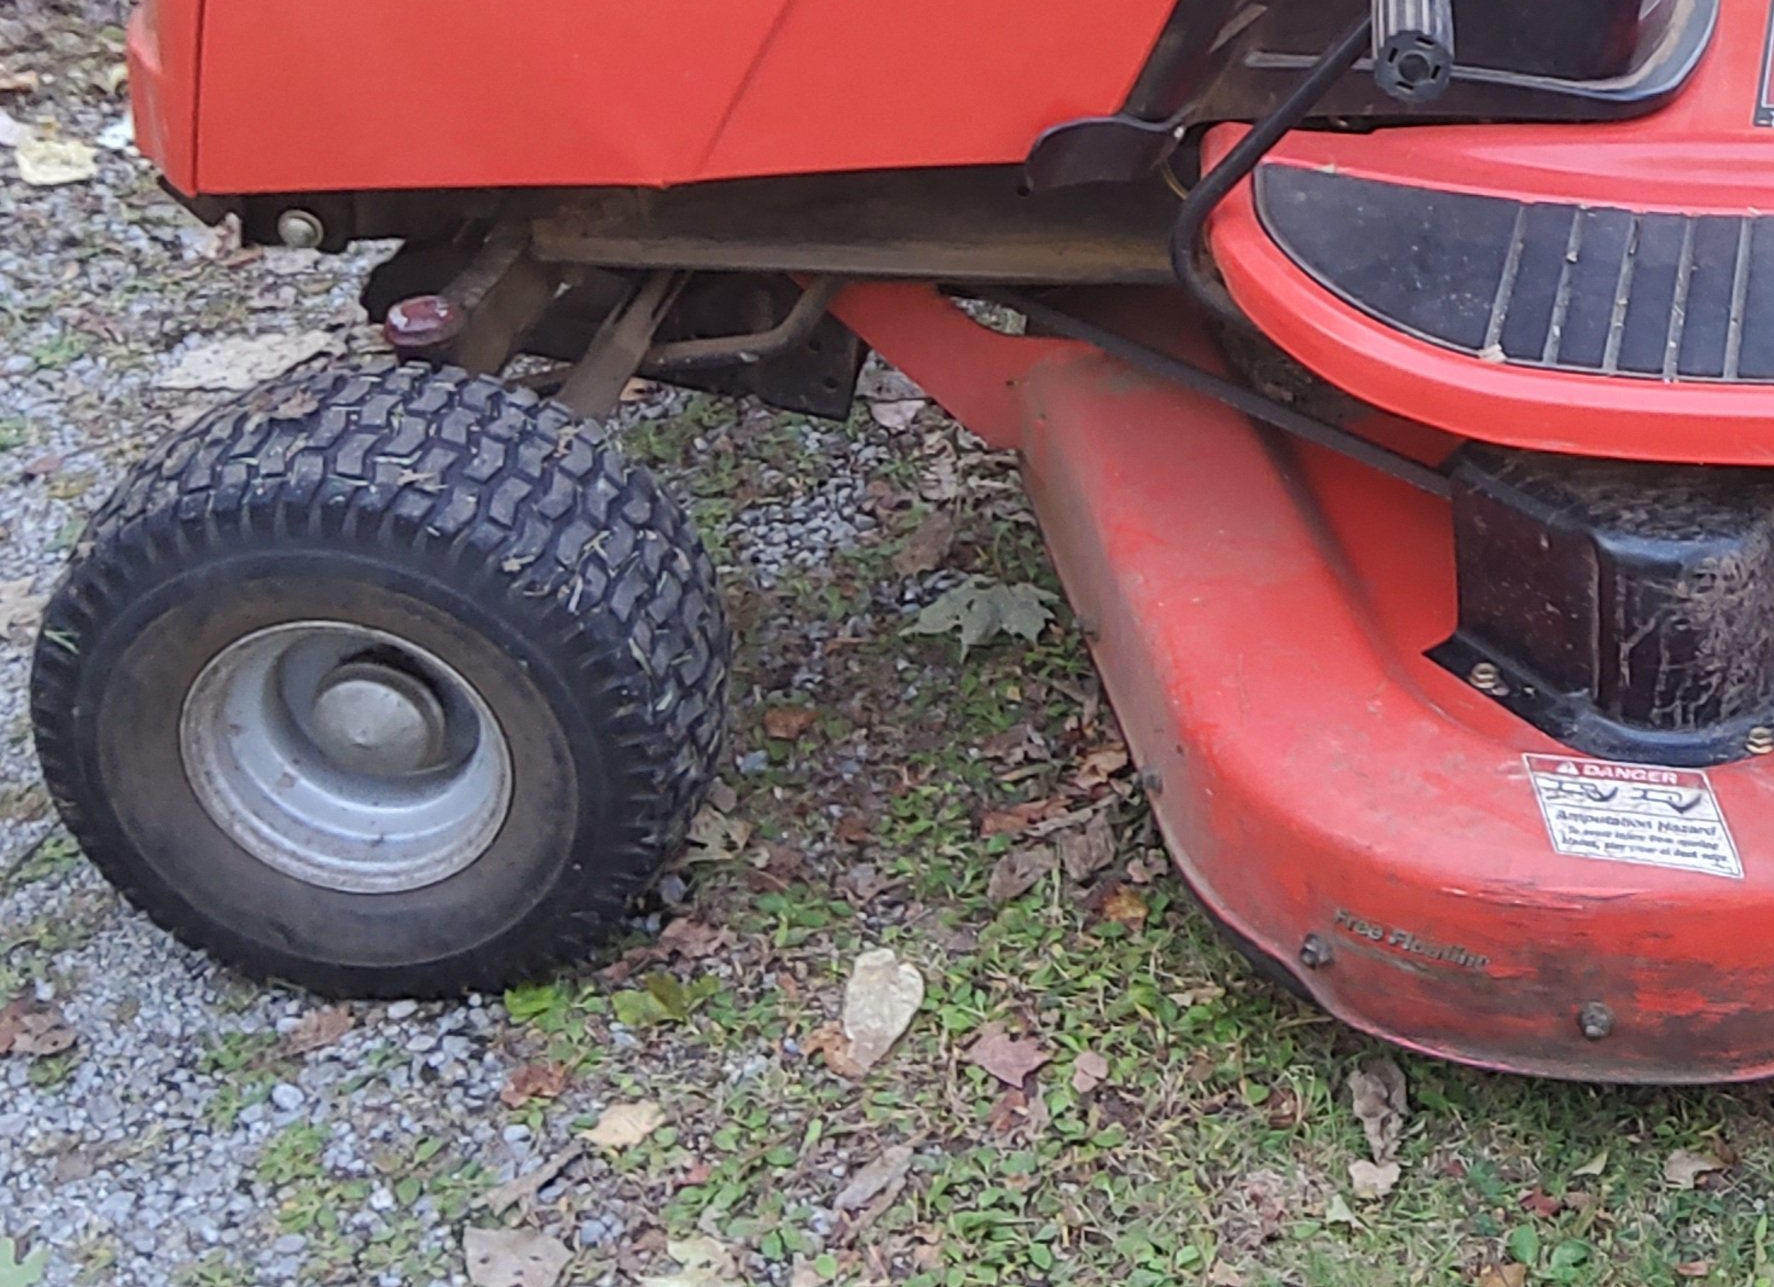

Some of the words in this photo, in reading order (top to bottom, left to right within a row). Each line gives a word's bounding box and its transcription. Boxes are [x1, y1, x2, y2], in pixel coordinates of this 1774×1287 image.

[1582, 764, 1677, 785] DANGER
[1556, 810, 1652, 830] Amputation
[1658, 819, 1716, 836] Hazard
[1334, 907, 1384, 941] Free
